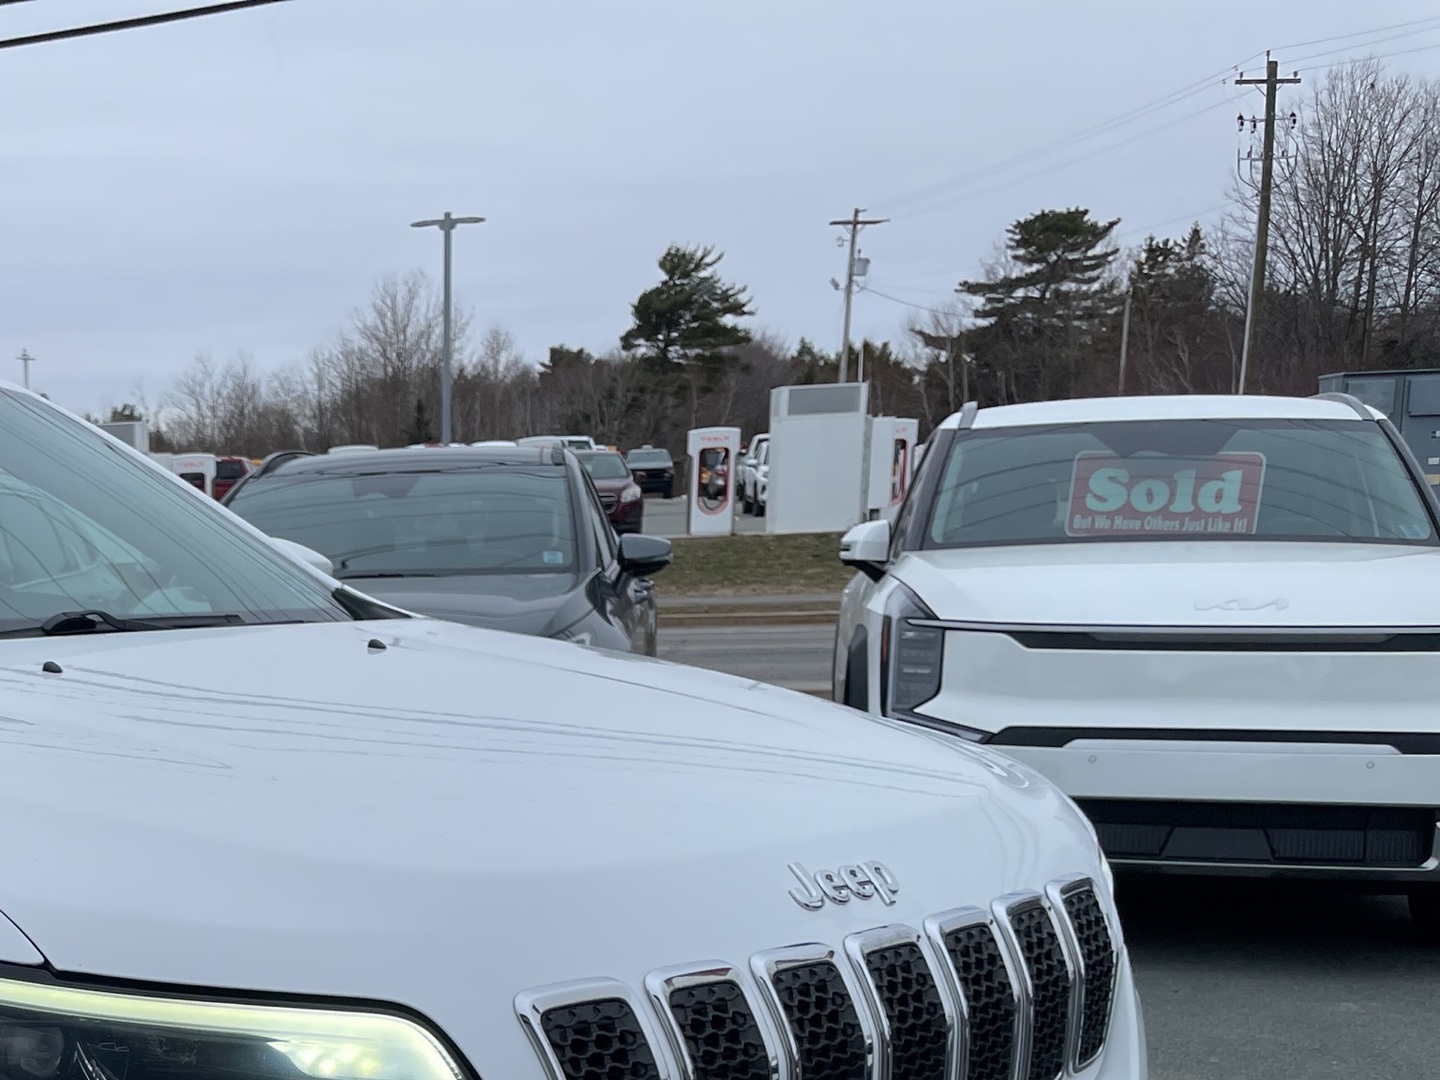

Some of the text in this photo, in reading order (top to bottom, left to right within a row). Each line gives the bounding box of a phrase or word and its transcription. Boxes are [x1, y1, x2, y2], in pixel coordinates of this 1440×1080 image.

[1085, 467, 1244, 514] Sold
[1073, 514, 1093, 529] But
[1094, 515, 1113, 530] We
[1113, 515, 1142, 531] Have
[1143, 515, 1180, 532] Others
[1181, 517, 1206, 532] Just
[1207, 517, 1230, 533] Like
[787, 860, 899, 911] Jeep
